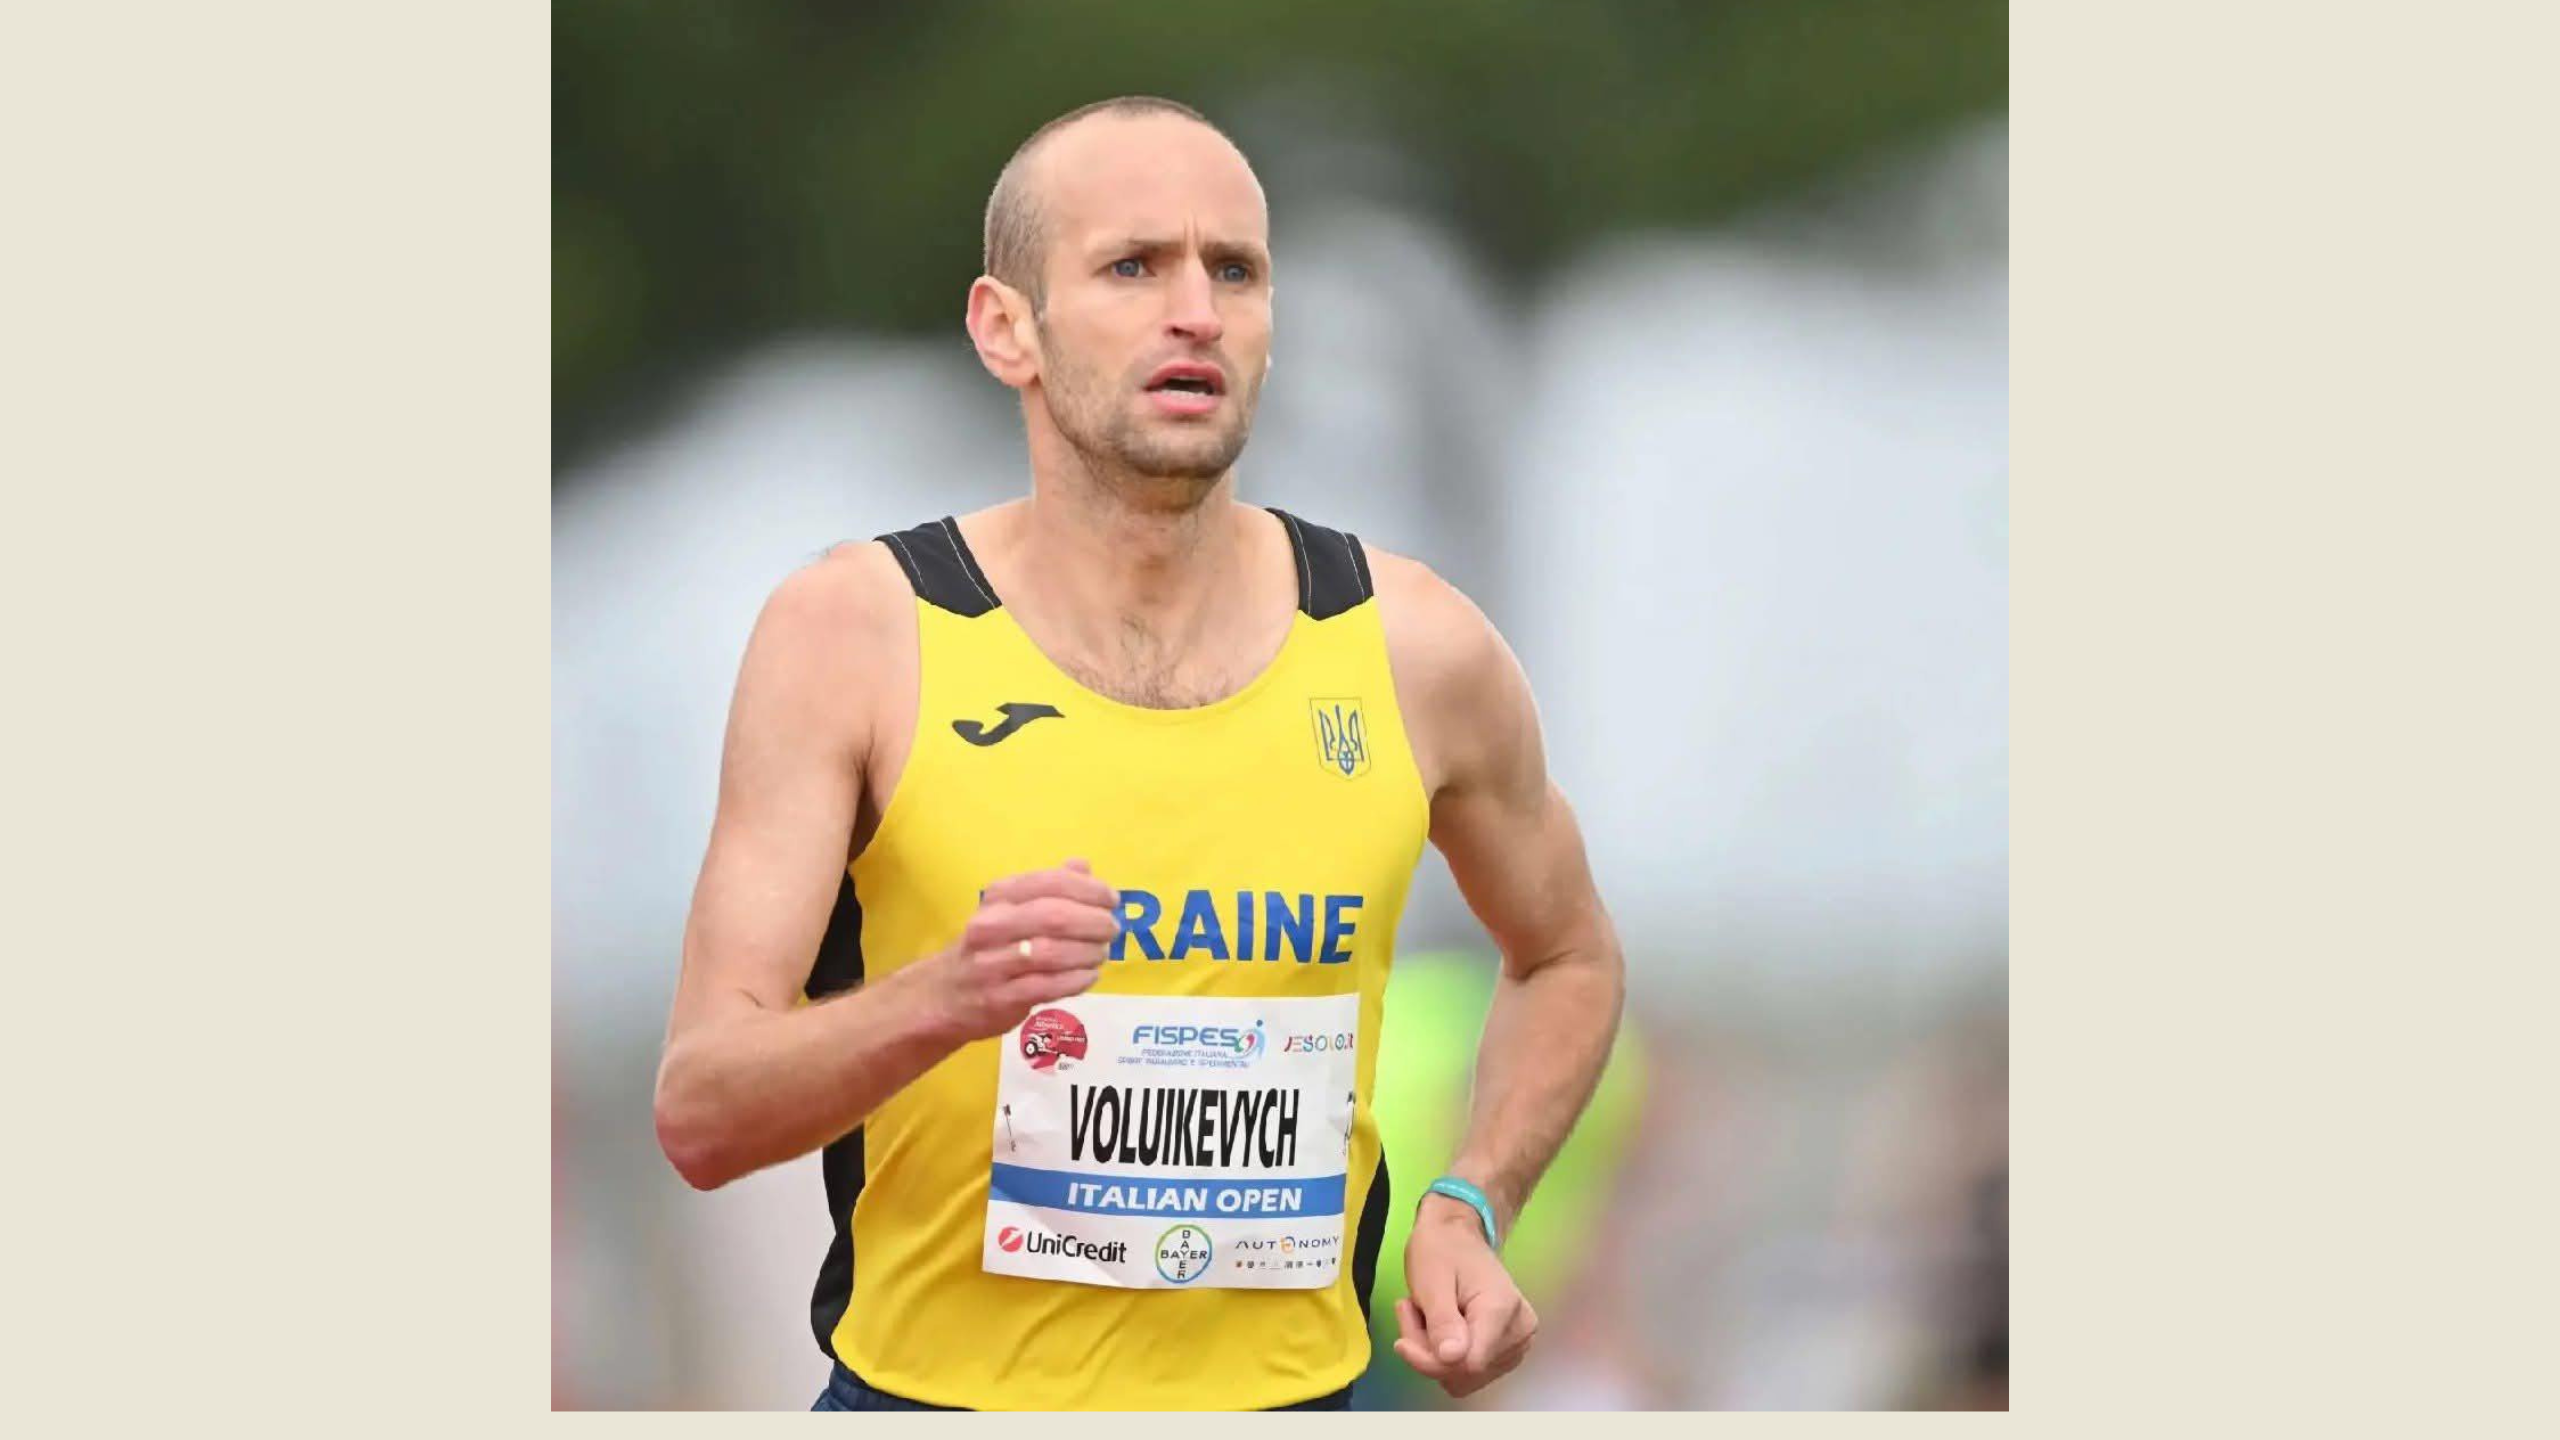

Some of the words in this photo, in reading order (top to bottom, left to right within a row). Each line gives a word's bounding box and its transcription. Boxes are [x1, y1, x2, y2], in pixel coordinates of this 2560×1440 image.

[980, 889, 1364, 964] RAINE
[1132, 1025, 1240, 1048] FISPES
[1069, 1084, 1300, 1168] VOLUIKEVYCH
[1067, 1182, 1209, 1212] ITALIAN
[1215, 1187, 1303, 1212] OPEN
[1026, 1230, 1127, 1264] UniCredit
[1159, 1249, 1208, 1261] BAYER
